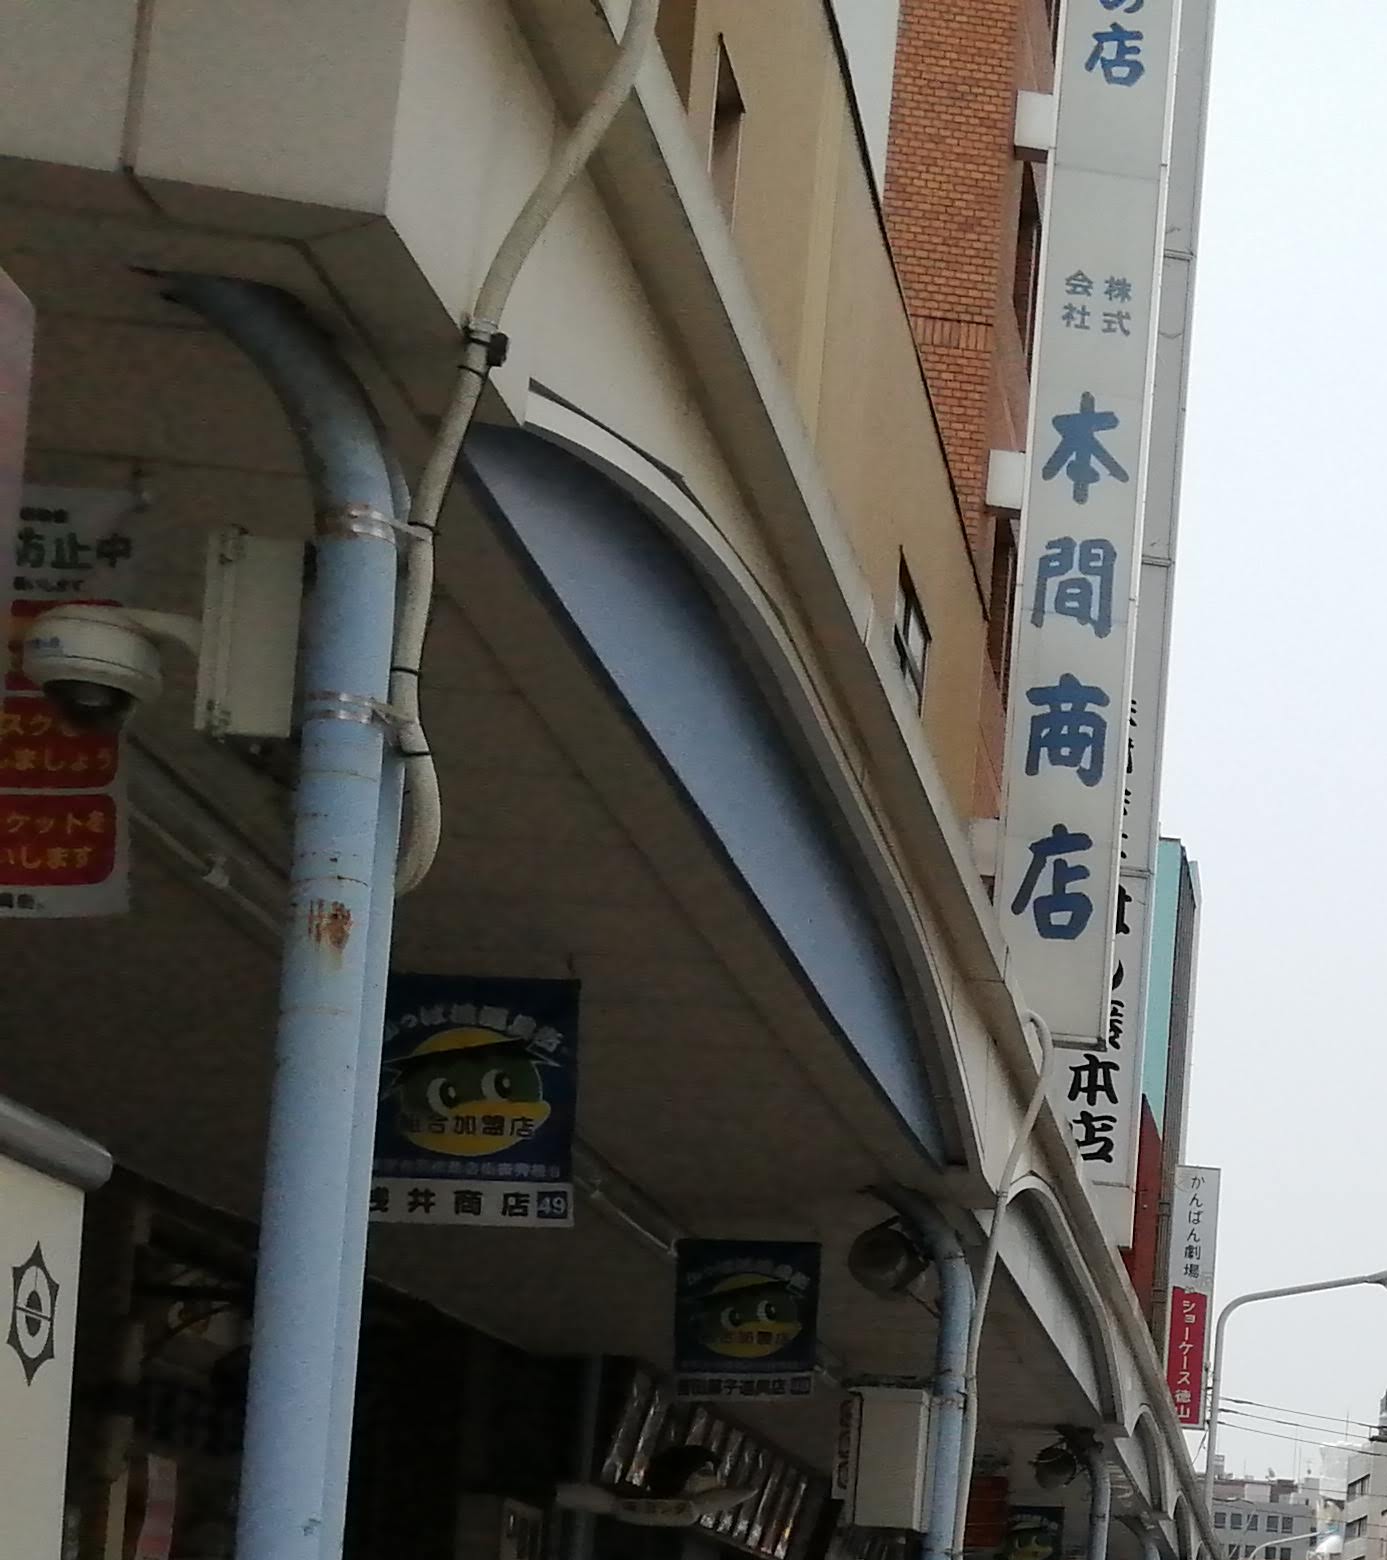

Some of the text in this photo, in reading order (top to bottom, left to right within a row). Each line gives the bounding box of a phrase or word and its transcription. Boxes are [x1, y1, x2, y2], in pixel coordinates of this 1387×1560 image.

[1085, 0, 1147, 87] 店
[1010, 390, 1130, 941] 本間商店
[1183, 1176, 1206, 1279] かんばん劇場
[1177, 1300, 1197, 1386] ショーケース
